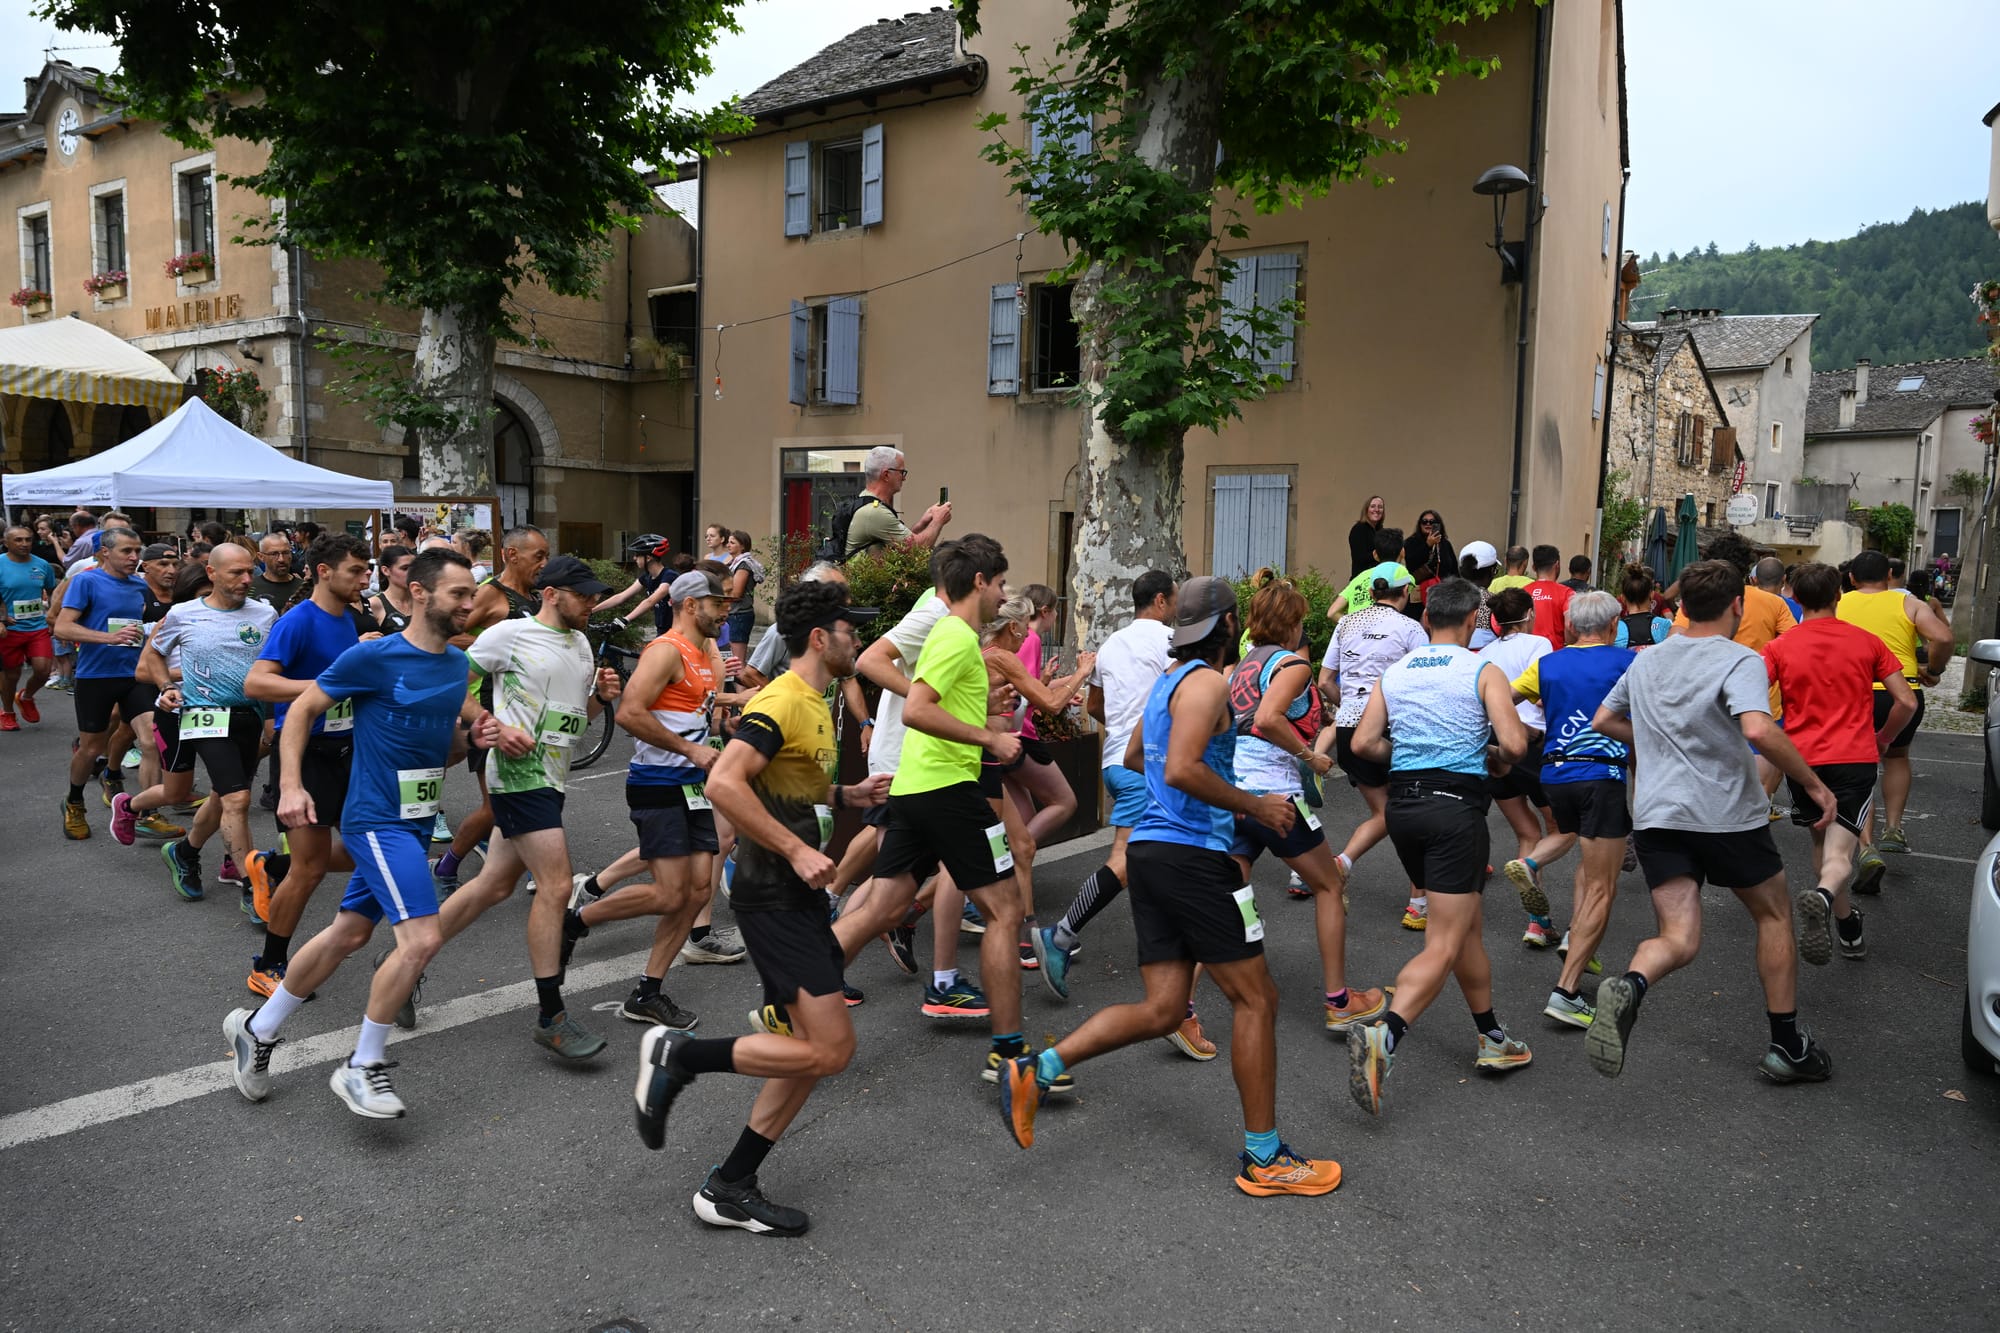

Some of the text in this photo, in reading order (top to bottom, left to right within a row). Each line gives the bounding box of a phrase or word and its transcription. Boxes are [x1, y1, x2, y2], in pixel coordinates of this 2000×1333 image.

[145, 293, 241, 331] MAIRIE
[1732, 460, 1746, 493] TABAC
[18, 603, 41, 613] 114
[191, 713, 215, 728] 19
[559, 715, 580, 735] 20
[416, 781, 437, 802] 50
